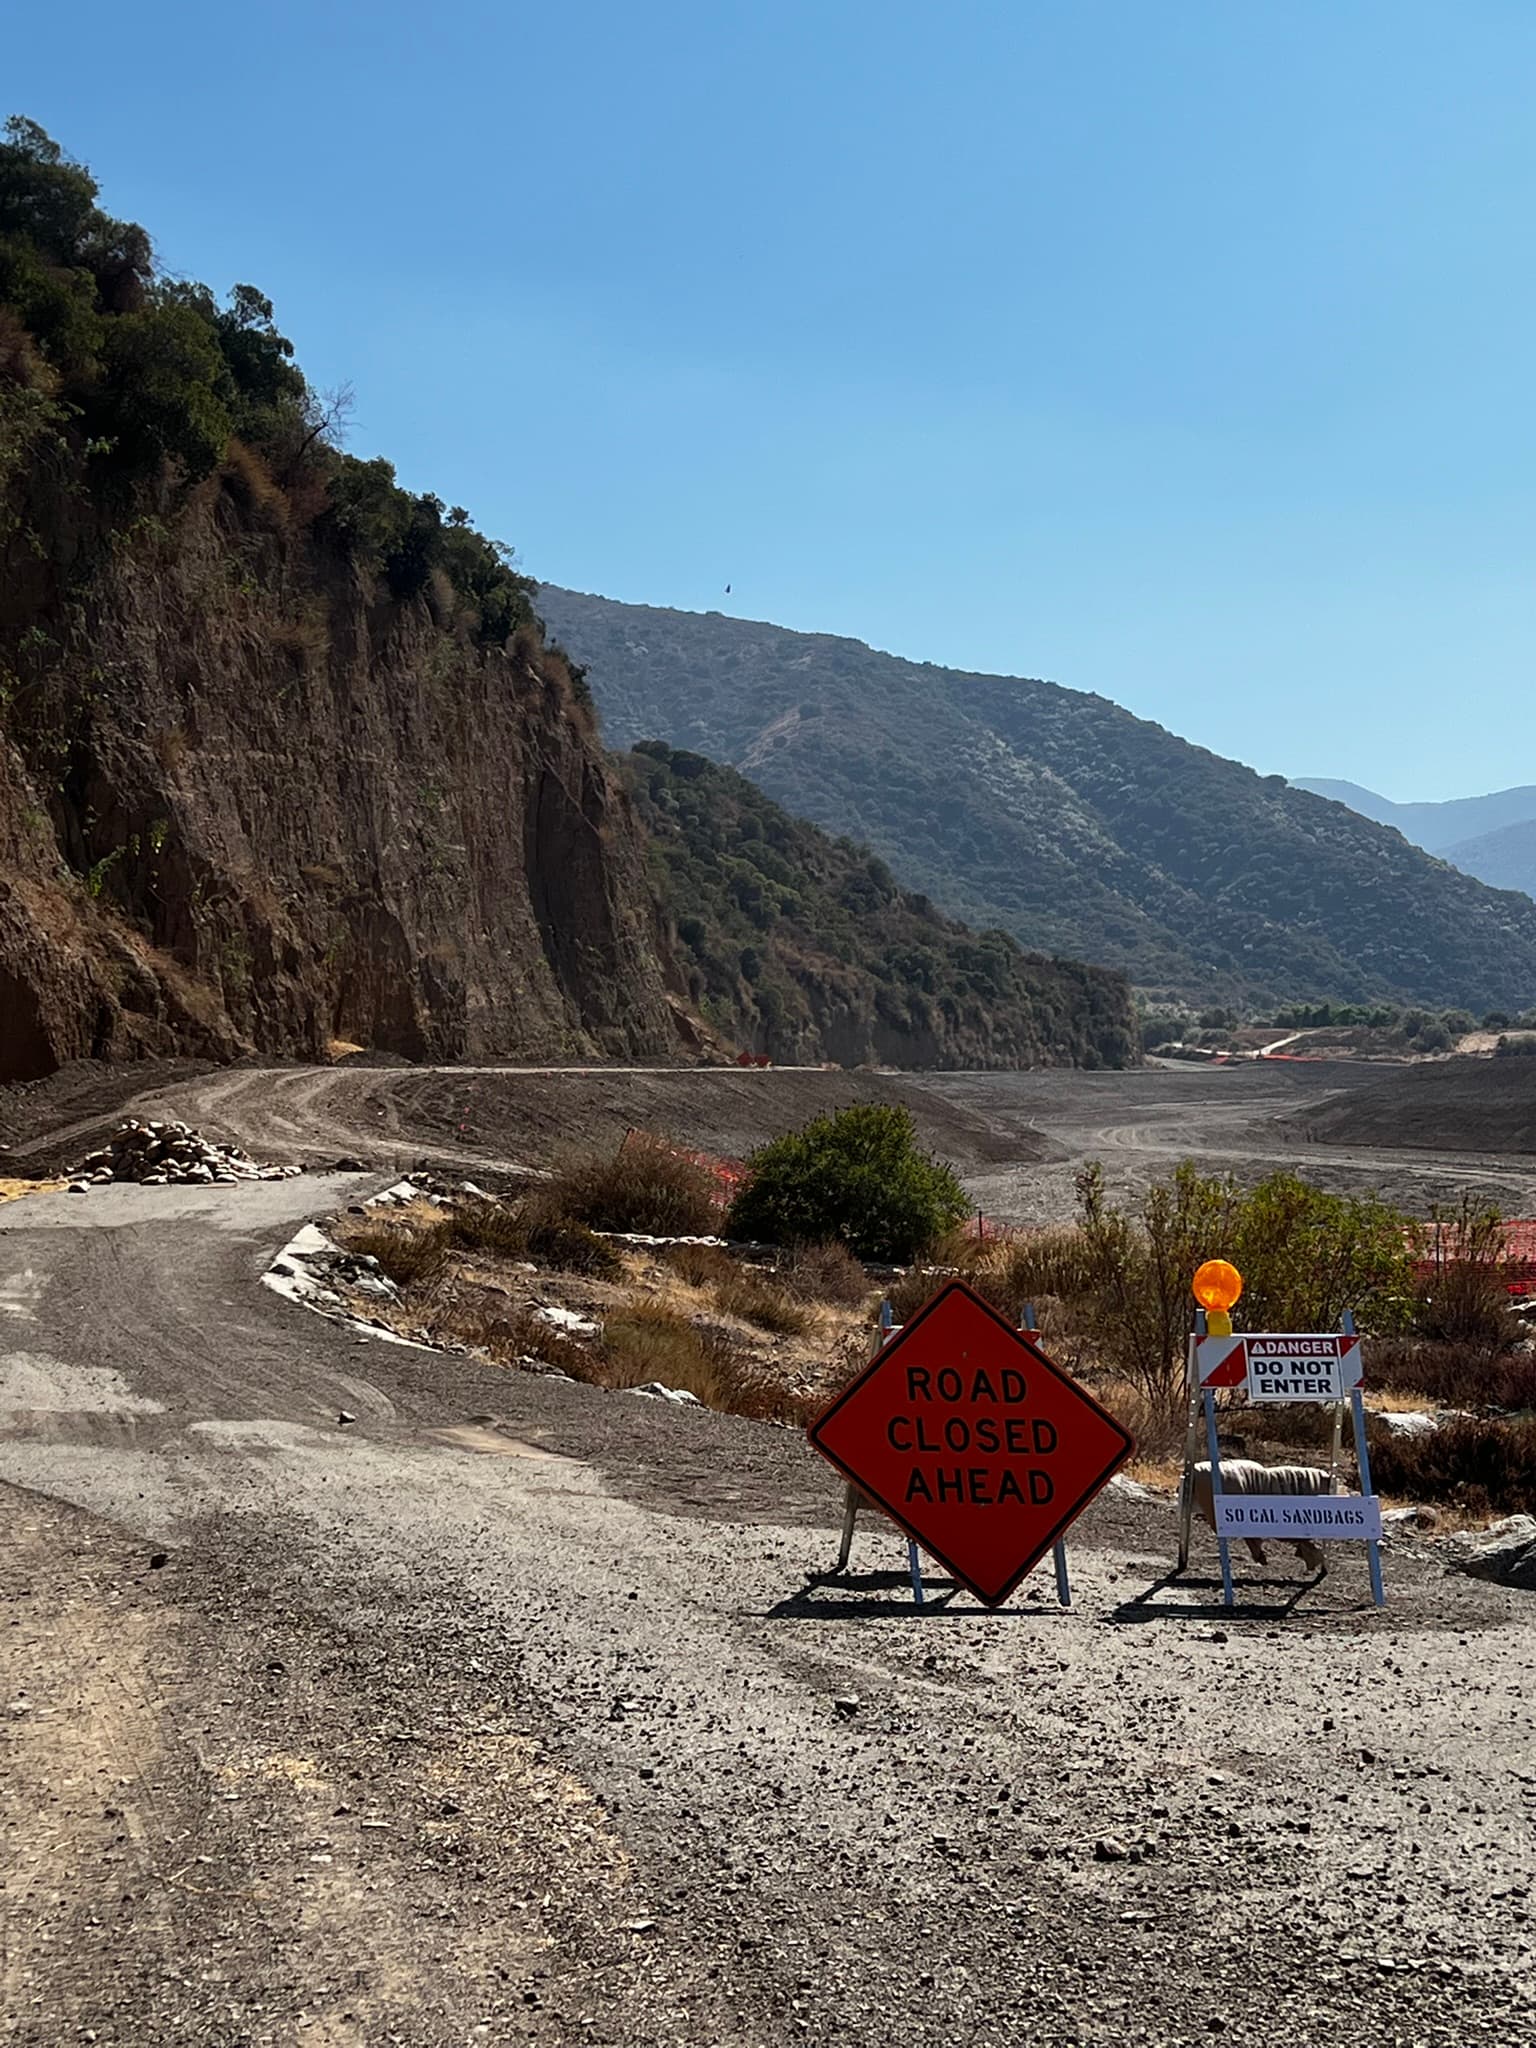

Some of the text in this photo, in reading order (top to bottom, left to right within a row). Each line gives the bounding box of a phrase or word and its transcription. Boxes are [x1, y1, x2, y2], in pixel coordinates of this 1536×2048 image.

[1266, 1341, 1334, 1354] DANGER
[1254, 1361, 1334, 1375] DO NOT
[906, 1367, 1028, 1404] ROAD
[1261, 1379, 1332, 1393] ENTER
[887, 1416, 1058, 1454] CLOSED
[904, 1467, 1055, 1505] AHEAD
[1224, 1508, 1365, 1525] SO CAL SANDBAGS
